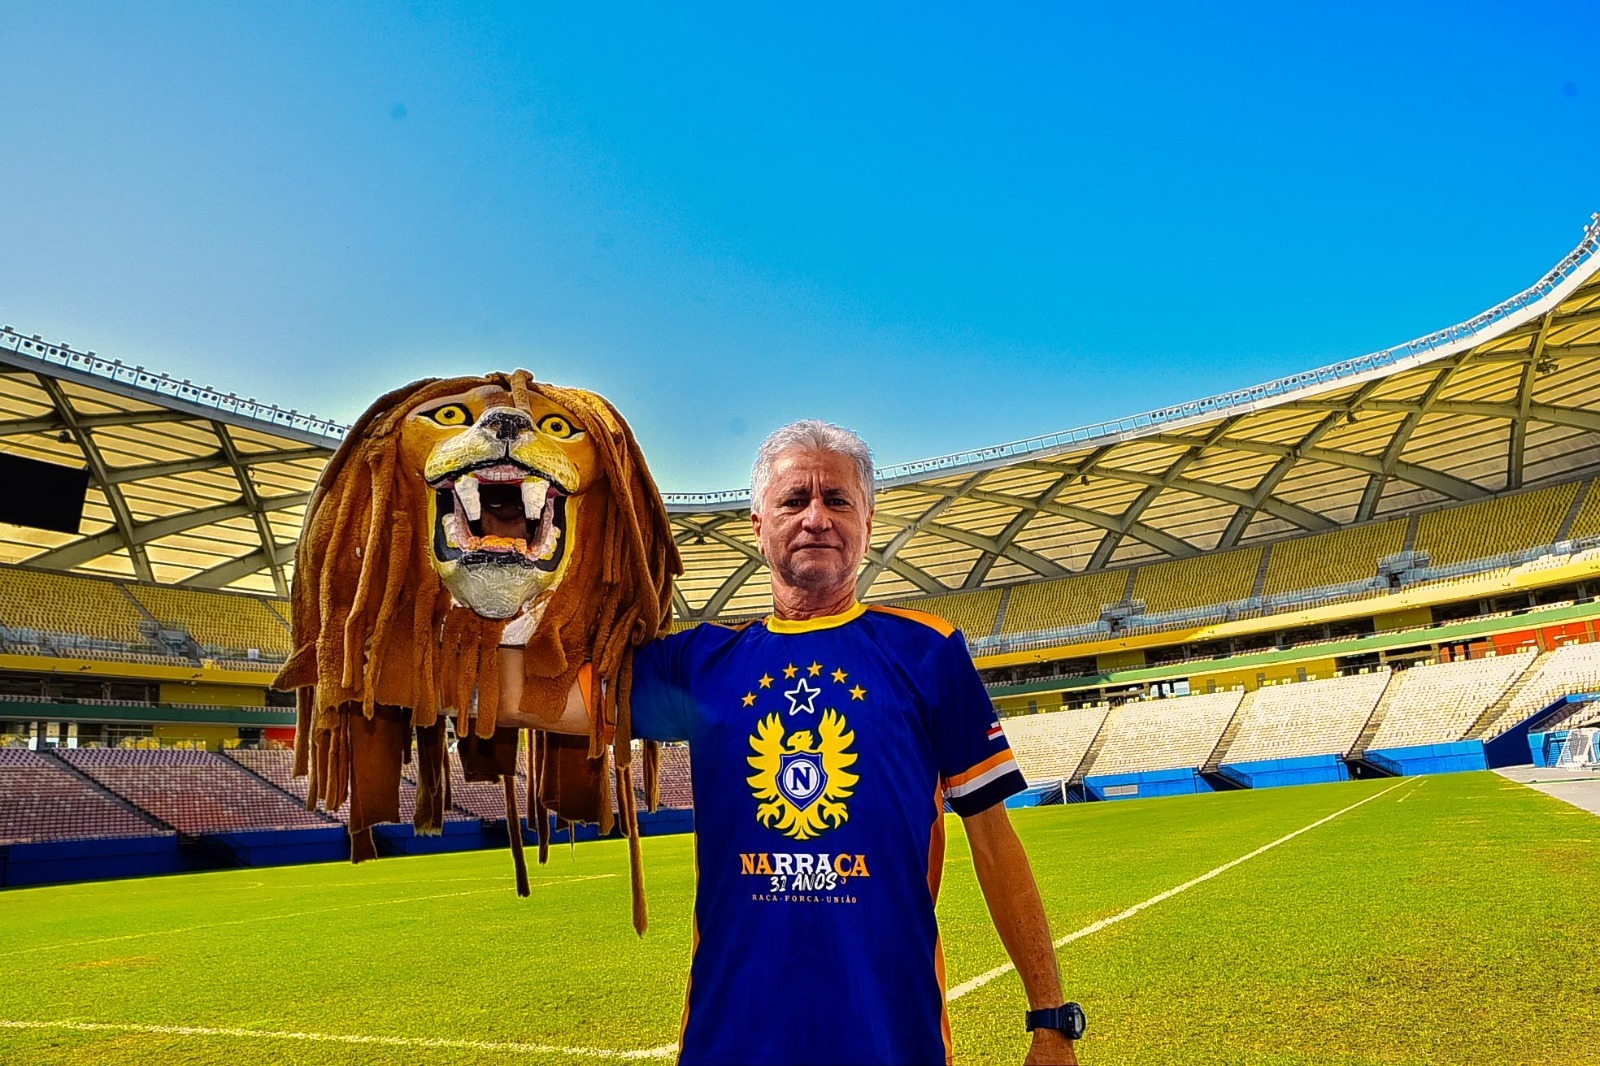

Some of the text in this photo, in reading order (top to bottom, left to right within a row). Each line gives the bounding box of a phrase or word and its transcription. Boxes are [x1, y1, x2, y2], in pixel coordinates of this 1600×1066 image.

[791, 766, 812, 791] N
[738, 853, 871, 885] NARRAÇA
[791, 871, 839, 891] ANOS
